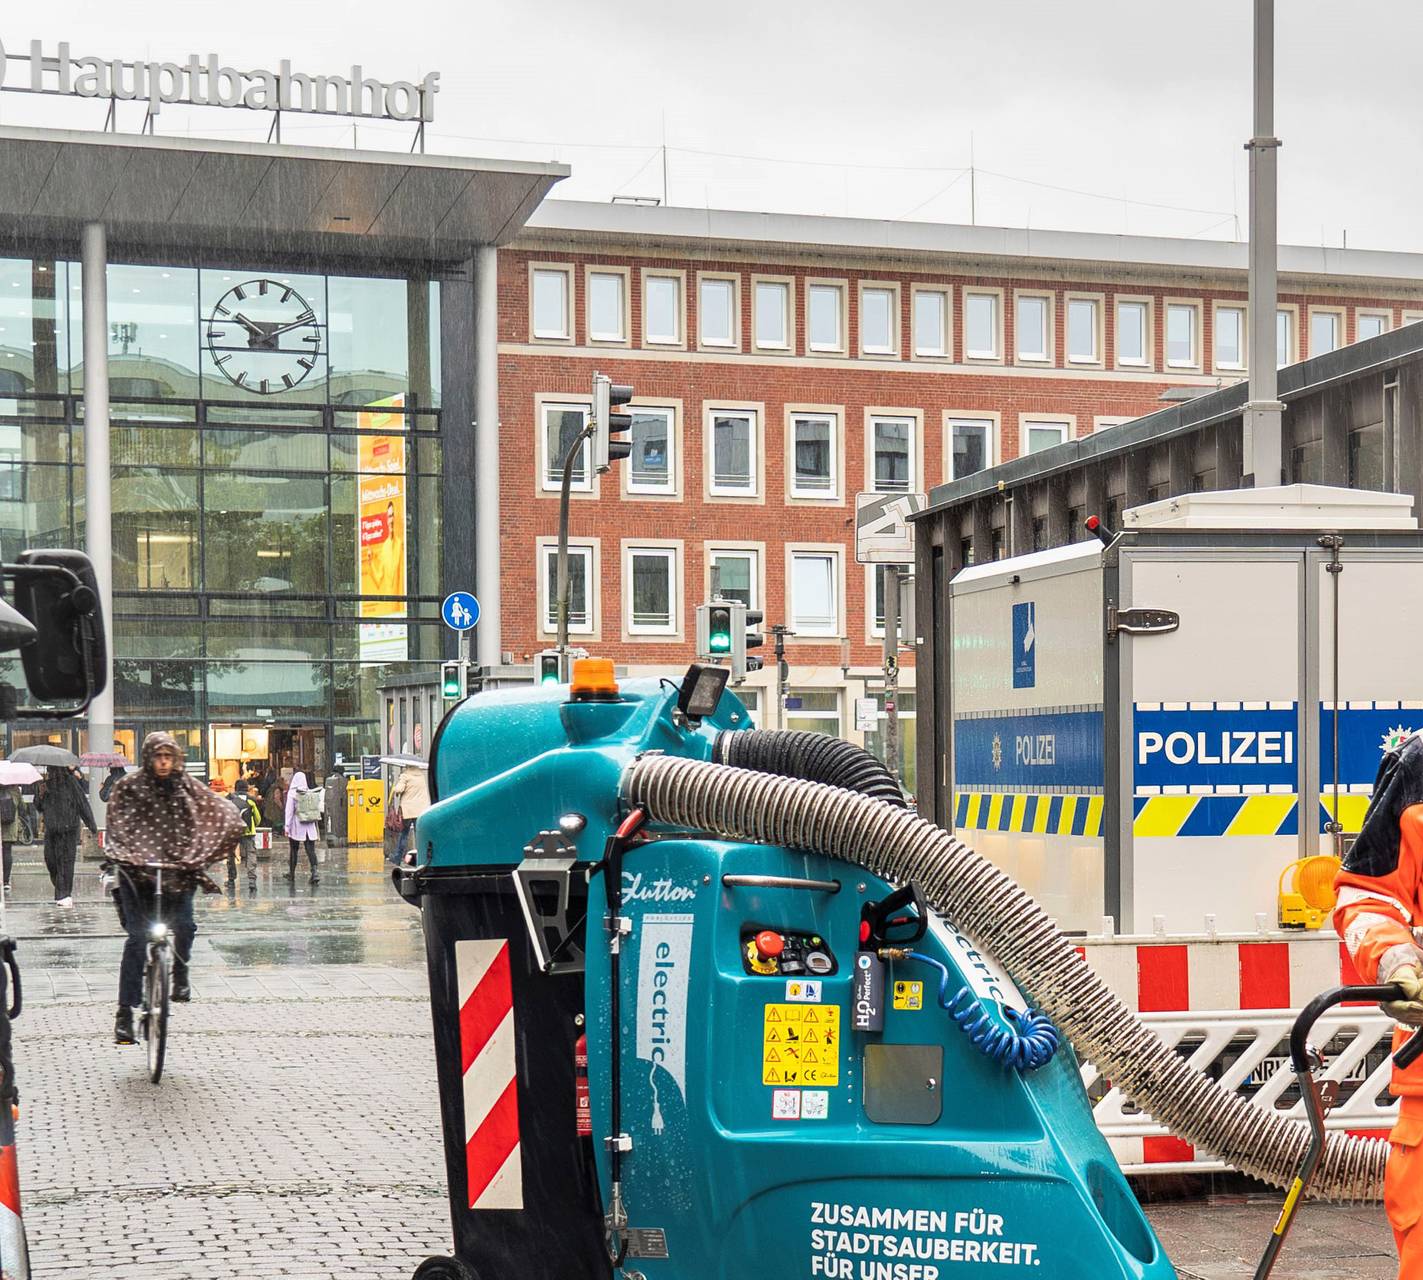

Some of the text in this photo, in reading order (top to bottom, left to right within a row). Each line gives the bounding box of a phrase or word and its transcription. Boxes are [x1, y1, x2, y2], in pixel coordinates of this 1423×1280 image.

[30, 39, 441, 122] Hauptbahnhof
[1016, 735, 1056, 765] POLIZEI
[1138, 731, 1293, 765] POLIZEI
[933, 911, 1004, 1001] lectric
[651, 942, 675, 1063] electric
[811, 1202, 1004, 1236] ZUSAMMEN FÜR
[811, 1229, 1041, 1266] STADTSAUBERKEIT.
[811, 1252, 854, 1279] FÜR
